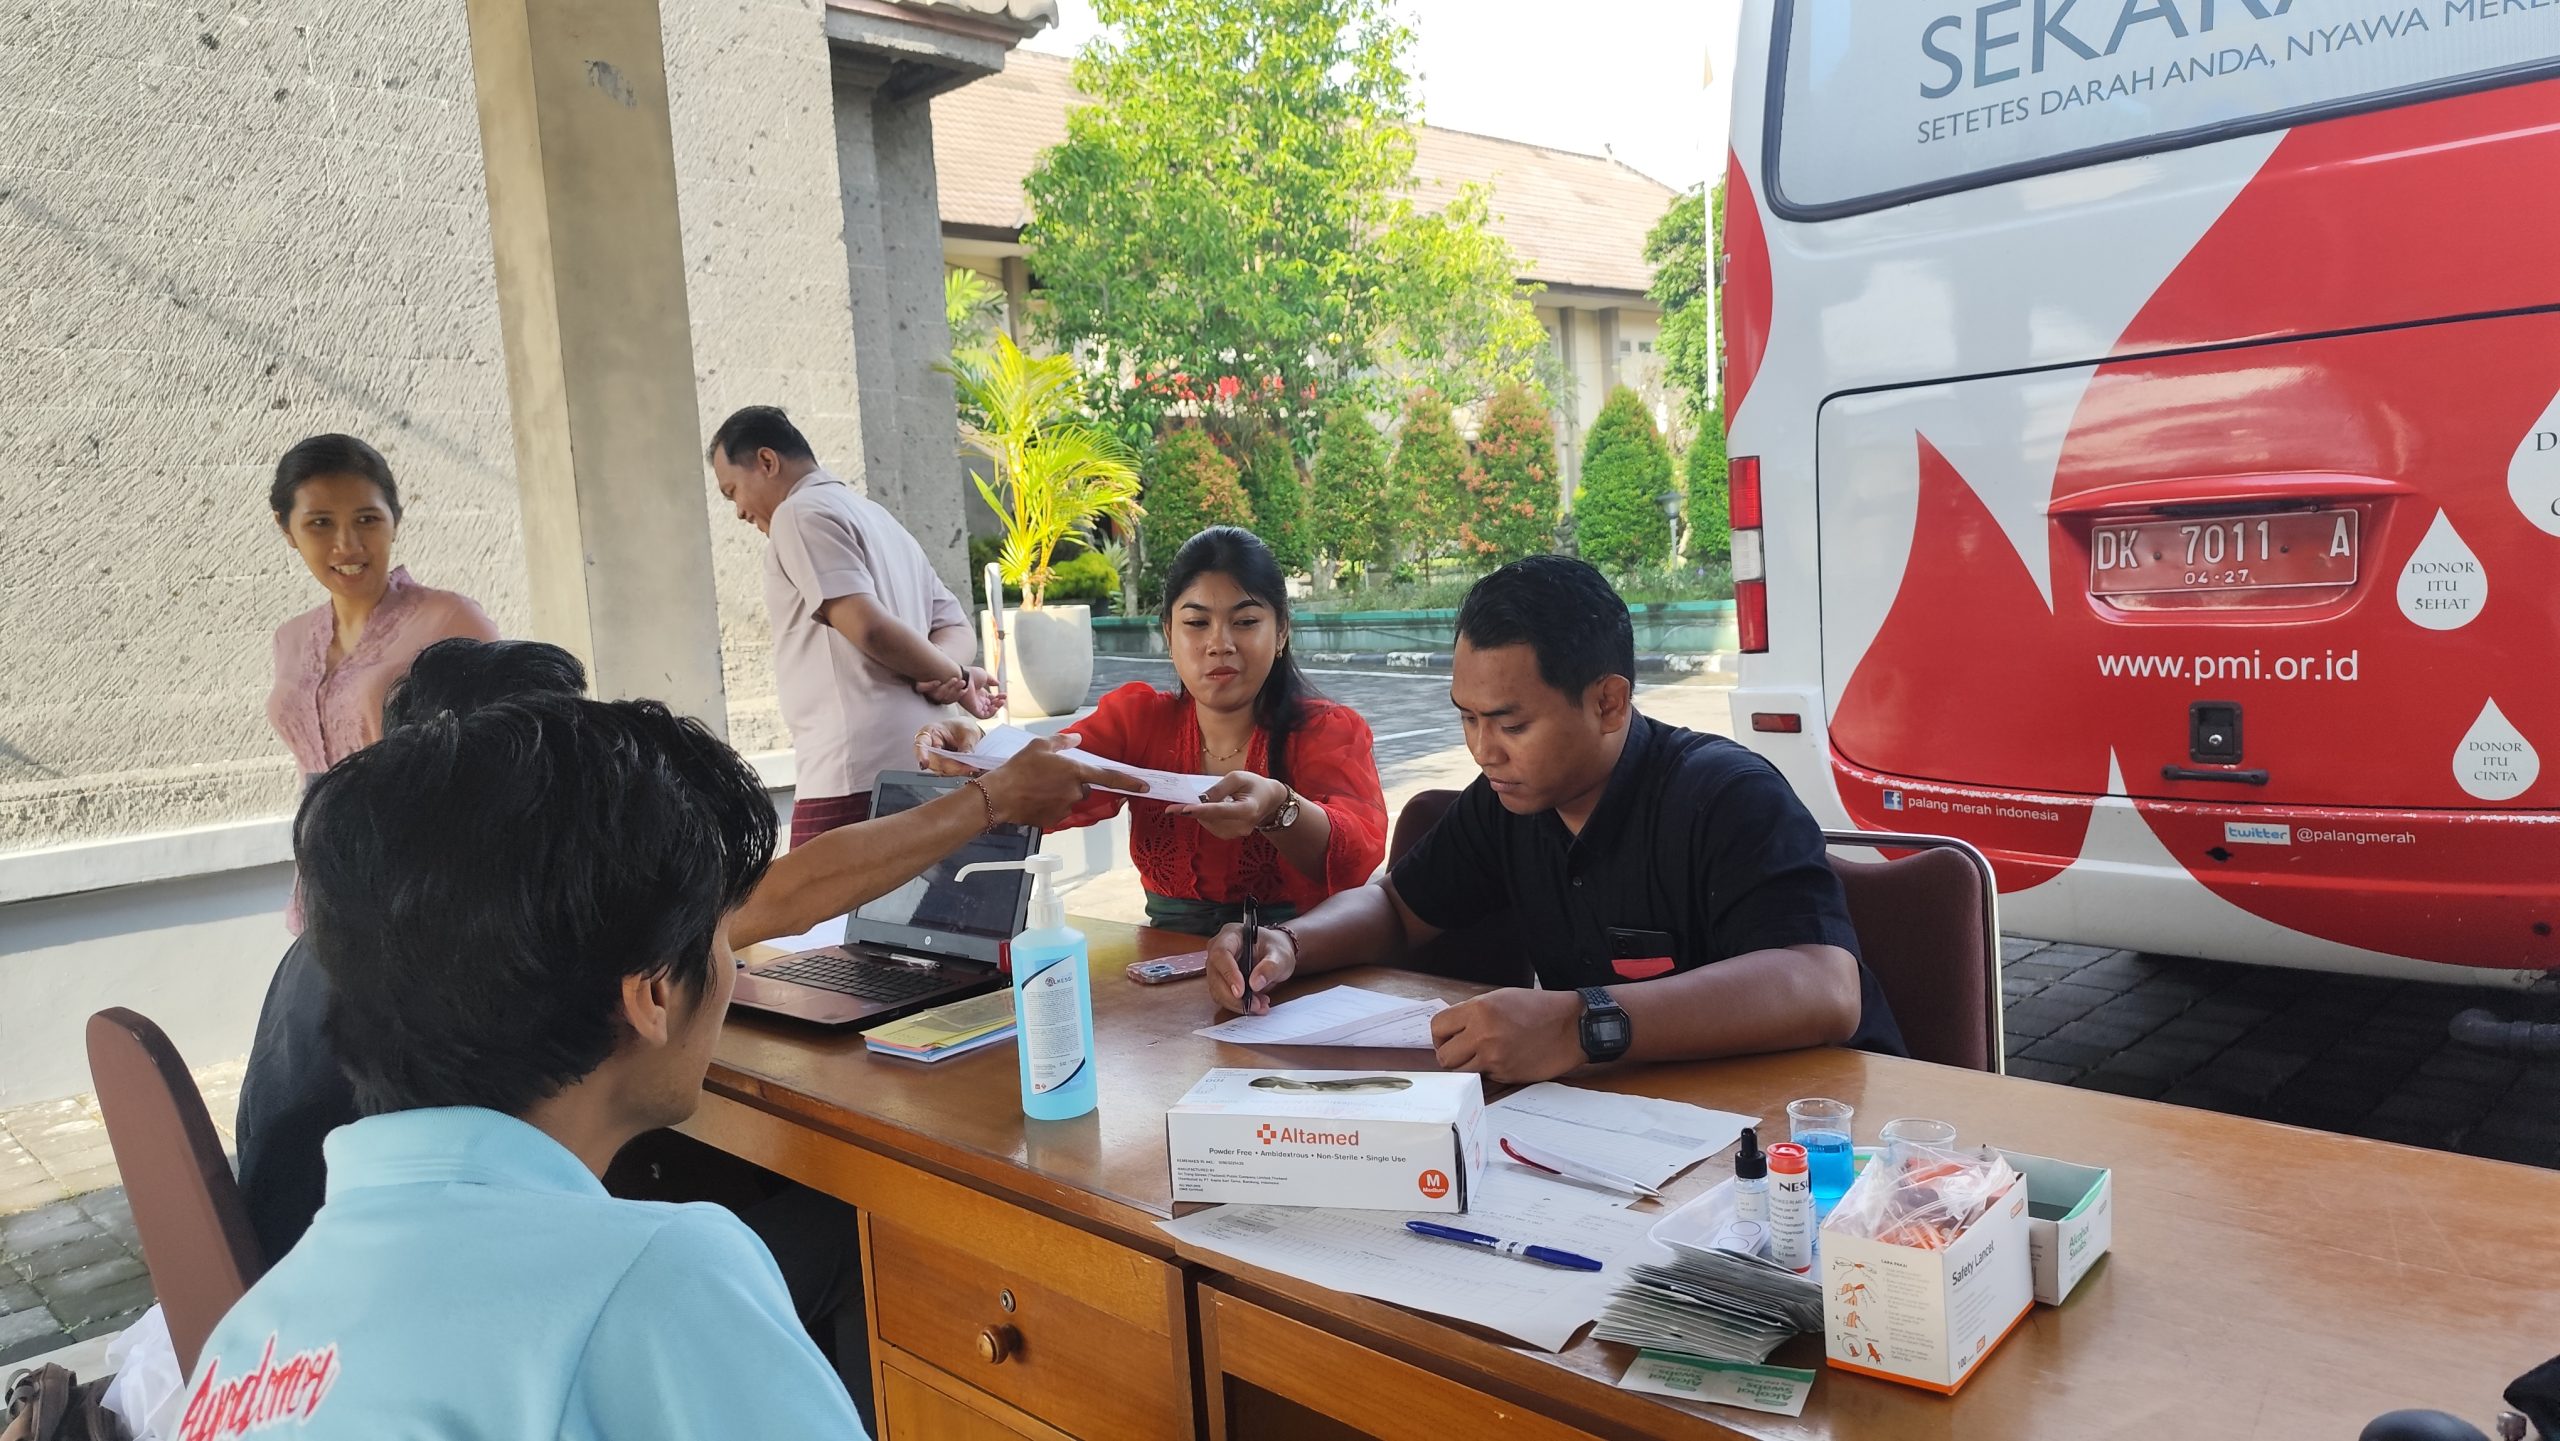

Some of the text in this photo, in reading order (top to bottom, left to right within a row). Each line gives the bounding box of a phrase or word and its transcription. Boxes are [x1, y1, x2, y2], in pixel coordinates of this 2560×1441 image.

[1920, 0, 2293, 99] SEKA
[1917, 96, 2029, 144] SETETES
[2040, 66, 2155, 116] DARAH
[2162, 42, 2276, 88] ANDA,
[2287, 7, 2430, 61] NYAWA
[2097, 516, 2350, 570] DK 7011 A
[2411, 561, 2476, 574] DONOR
[2427, 580, 2458, 592] ITU
[2414, 598, 2470, 610] SEHAT
[2097, 650, 2358, 687] www.pmi.or.id
[2469, 741, 2523, 752] DONOR
[2483, 756, 2508, 767] ITU
[2474, 770, 2518, 782] CINTA
[1908, 796, 1949, 814] palang
[1952, 801, 1992, 816] merah
[1995, 806, 2060, 822] indonesia
[2228, 825, 2417, 845] twitter @palangmerah
[1280, 1127, 1360, 1147] Altamed
[1208, 1147, 1407, 1164] Powder Free Ambidextrous Non-Sterile Single Use
[1426, 1173, 1441, 1187] M
[2069, 1220, 2090, 1249] Alcohol
[1952, 1258, 1974, 1287] Safety
[1974, 1239, 1995, 1269] Lancet
[1957, 1355, 1968, 1370] 100
[1736, 1386, 1793, 1401] Alcohol
